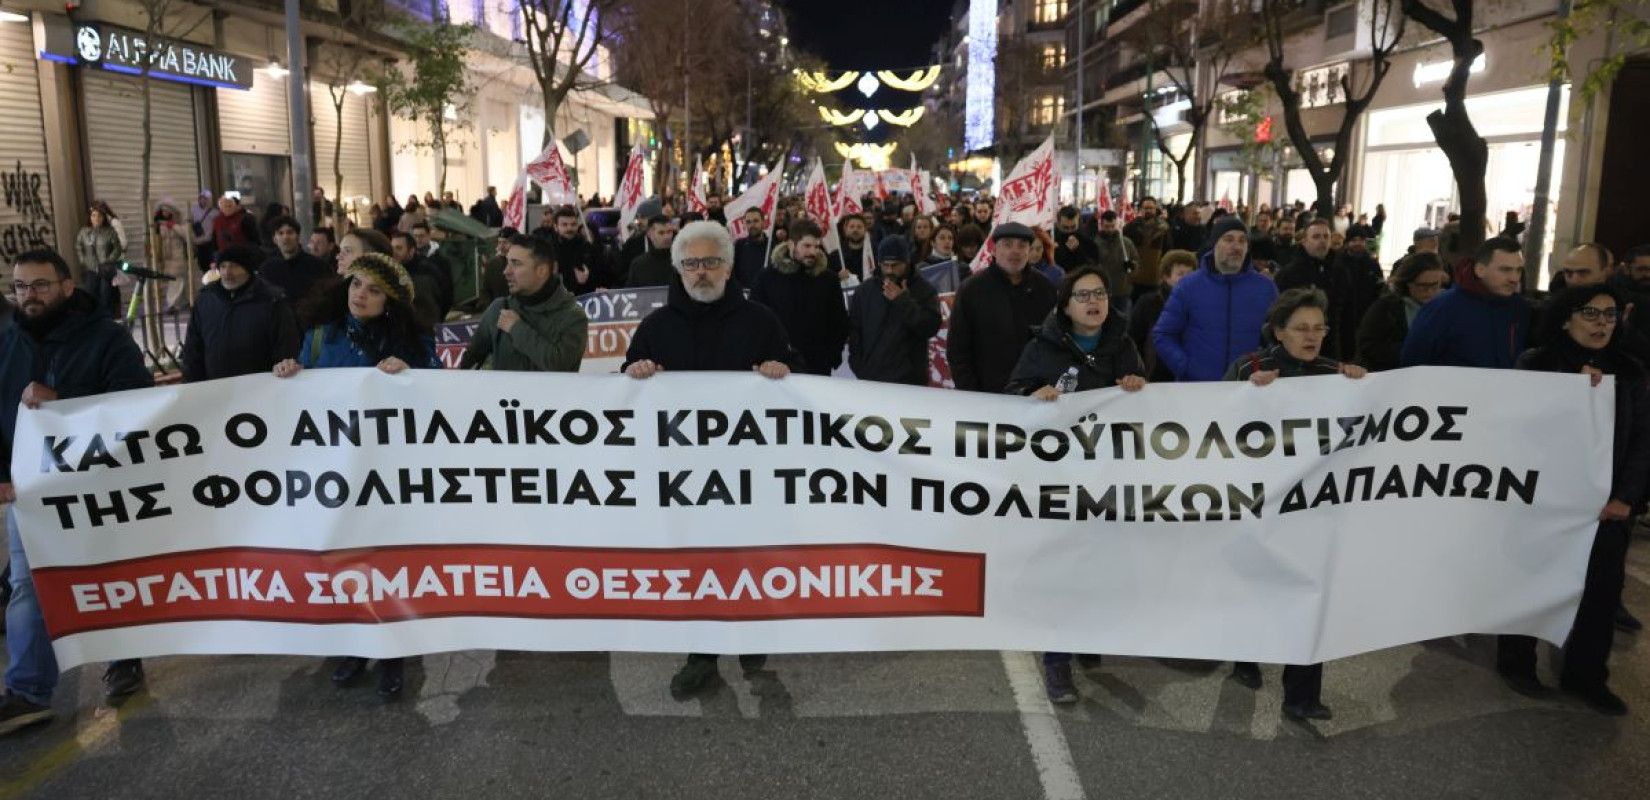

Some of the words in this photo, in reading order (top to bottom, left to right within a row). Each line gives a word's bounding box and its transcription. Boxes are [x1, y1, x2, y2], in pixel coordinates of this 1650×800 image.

[182, 47, 238, 82] BANK
[576, 292, 639, 320] ΟΥΣ
[40, 423, 204, 474] ΚΑΤΩ
[225, 412, 268, 449] Ο
[290, 398, 637, 448] ΑΝΤΙΛΑΪΚΟΣ
[656, 408, 933, 457] ΚΡΑΤΙΚΟΣ
[954, 405, 1469, 463] ΠΡΟΫΠΟΛΟΓΙΣΜΟΣ
[42, 482, 173, 530] ΤΗΣ
[192, 466, 637, 509] ΦΟΡΟΛΗΣΤΕΙΑΣ
[658, 467, 752, 507] ΚΑΙ
[773, 466, 888, 508] ΤΩΝ
[910, 476, 1266, 523] ΠΟΛΕΜΙΚΩΝ
[1278, 462, 1540, 515] ΔΑΠΑΝΩΝ
[70, 566, 295, 613] ΕΡΓΑΤΙΚΑ
[303, 564, 552, 605] ΣΩΜΑΤΕΙΑ
[564, 563, 944, 600] ΘΕΣΣΑΛΟΝΙΚΗΣ
